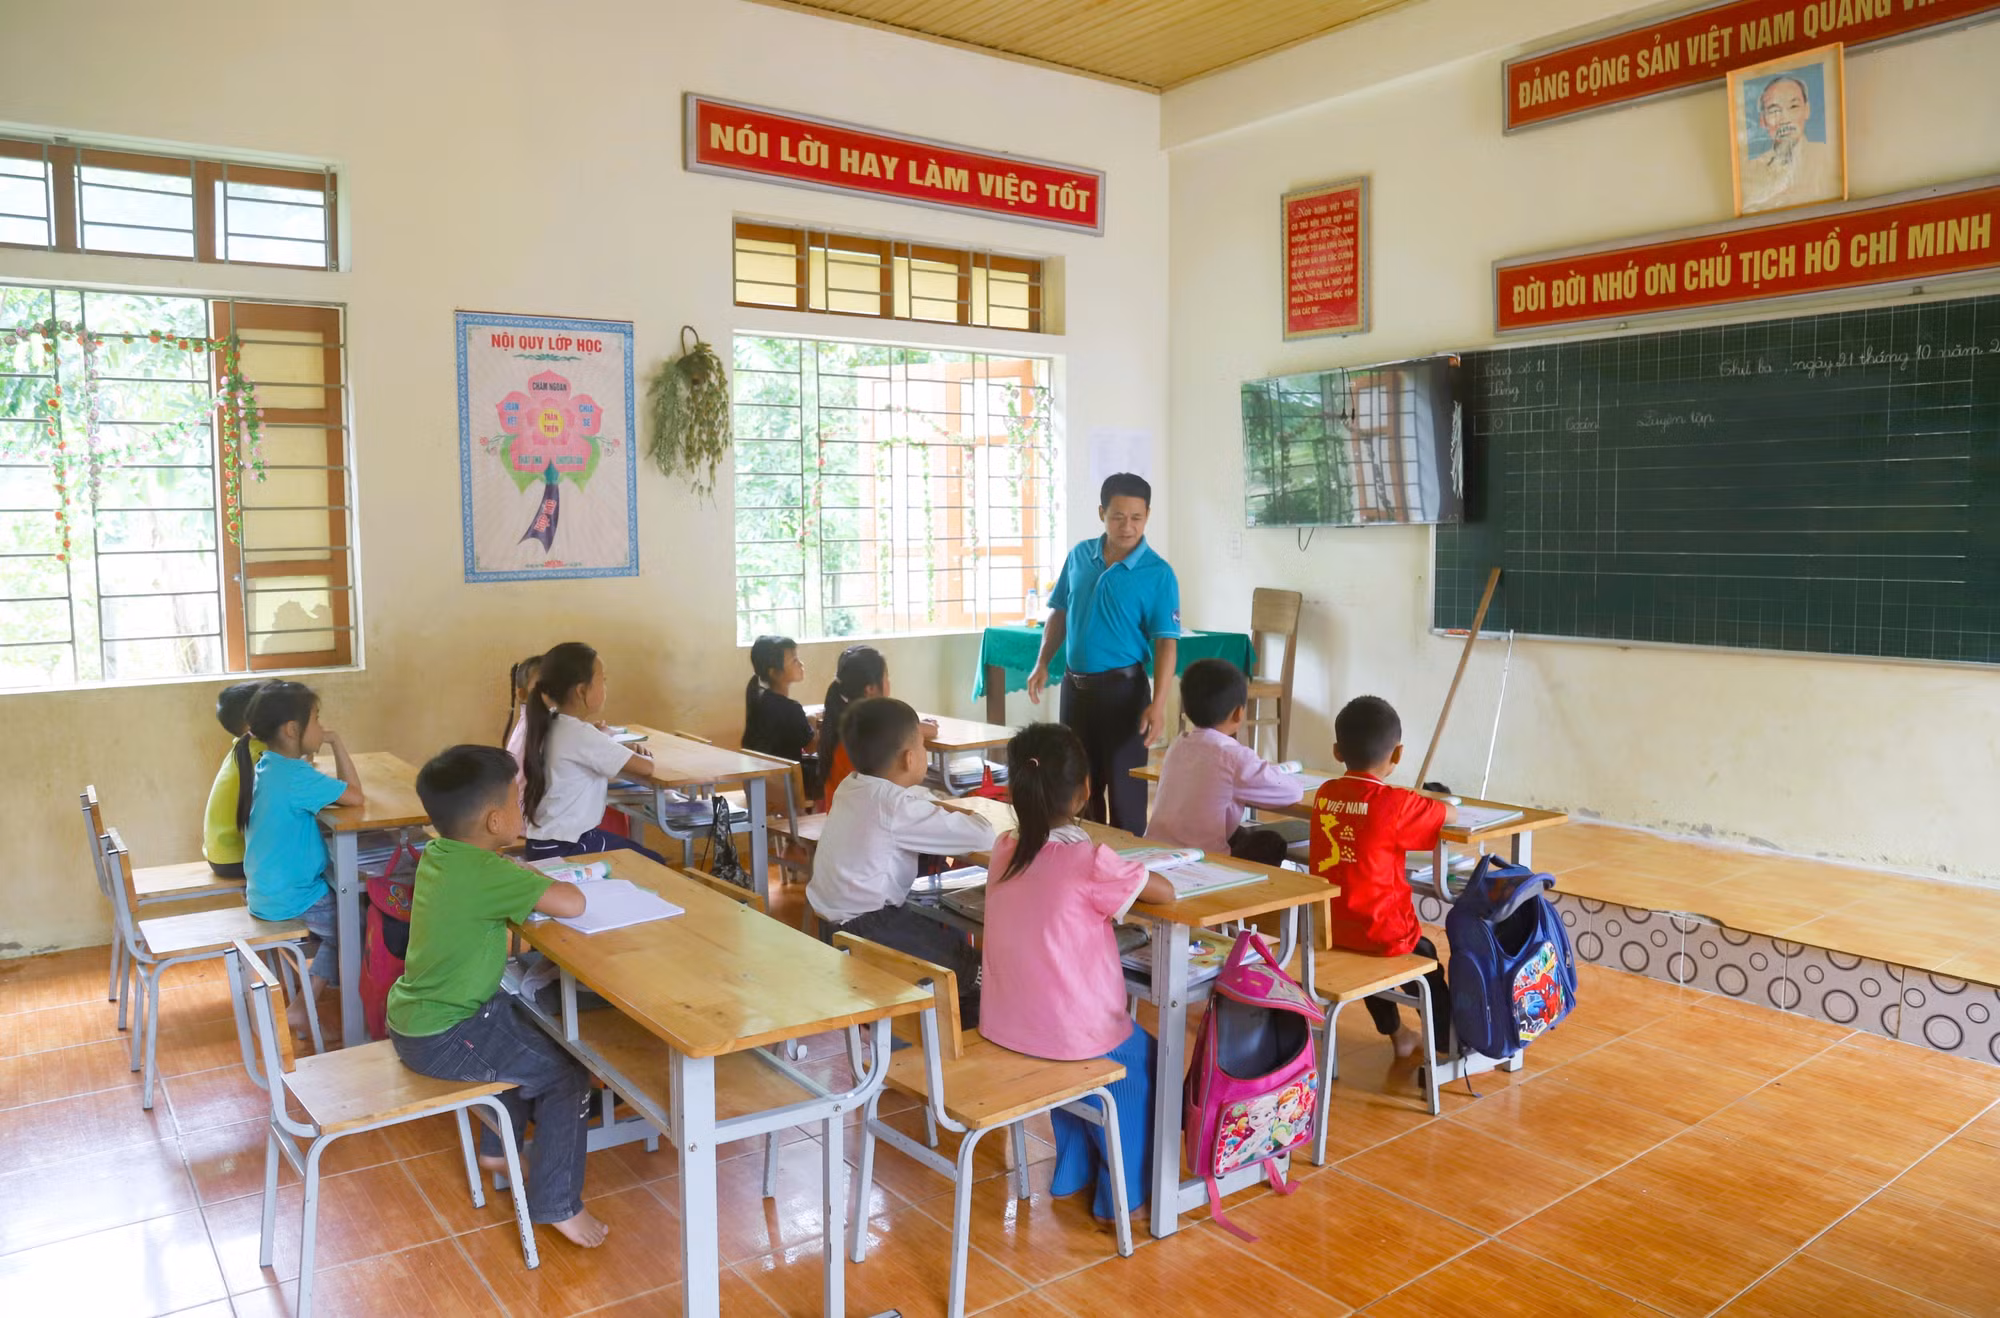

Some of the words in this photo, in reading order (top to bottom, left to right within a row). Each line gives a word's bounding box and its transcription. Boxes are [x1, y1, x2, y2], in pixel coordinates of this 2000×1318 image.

[1519, 67, 1570, 108] ĐẢNG
[1576, 55, 1630, 95] CỘNG
[1637, 34, 1680, 78] SẢN
[1686, 25, 1733, 68] VIỆT
[1740, 11, 1795, 53] NAM
[710, 122, 769, 158] NÓI
[780, 134, 829, 169] LỜI
[840, 147, 899, 181] HAY
[908, 159, 969, 193] LÀM
[978, 172, 1037, 206] VIỆC
[1045, 180, 1090, 213] TỐT
[1512, 276, 1546, 313] ĐỜI
[1552, 270, 1586, 307] ĐỜI
[1593, 260, 1639, 303] NHỚ
[1644, 263, 1676, 296] ƠN
[1683, 243, 1731, 291] CHỦ
[1739, 245, 1796, 289] TỊCH
[1804, 227, 1841, 275] HỒ
[1850, 222, 1898, 268] CHÍ
[1907, 213, 1991, 260] MINH
[491, 331, 515, 352] NỘI
[519, 335, 544, 352] QUY
[548, 333, 573, 351] LỚP
[576, 338, 603, 355] HỌC
[1860, 345, 1909, 371] tháng
[1916, 344, 1931, 360] 10
[1345, 801, 1369, 816] NAM
